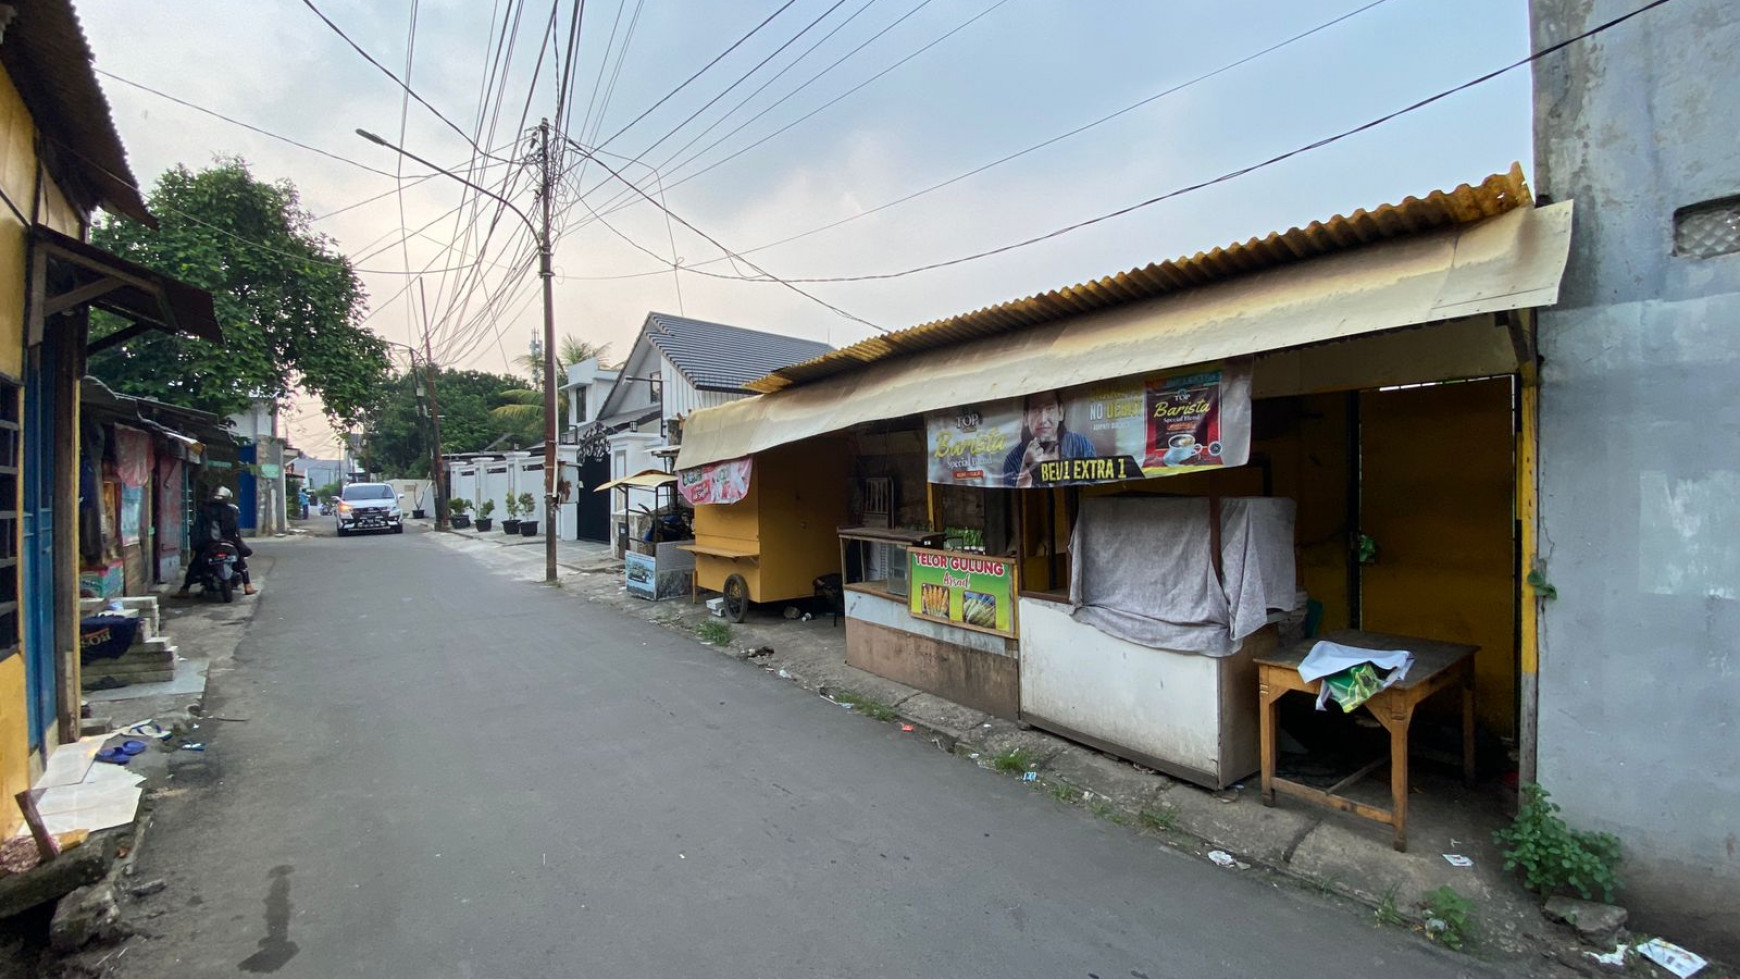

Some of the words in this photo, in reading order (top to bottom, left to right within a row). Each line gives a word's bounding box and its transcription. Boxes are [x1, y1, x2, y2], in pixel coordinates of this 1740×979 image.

[1090, 402, 1103, 421] NO
[1153, 398, 1210, 418] Barista
[956, 413, 979, 428] TOP
[1073, 458, 1114, 480] EXTRA
[1118, 458, 1127, 479] 1
[914, 552, 948, 569] TELOR
[950, 556, 1005, 576] GULUNG
